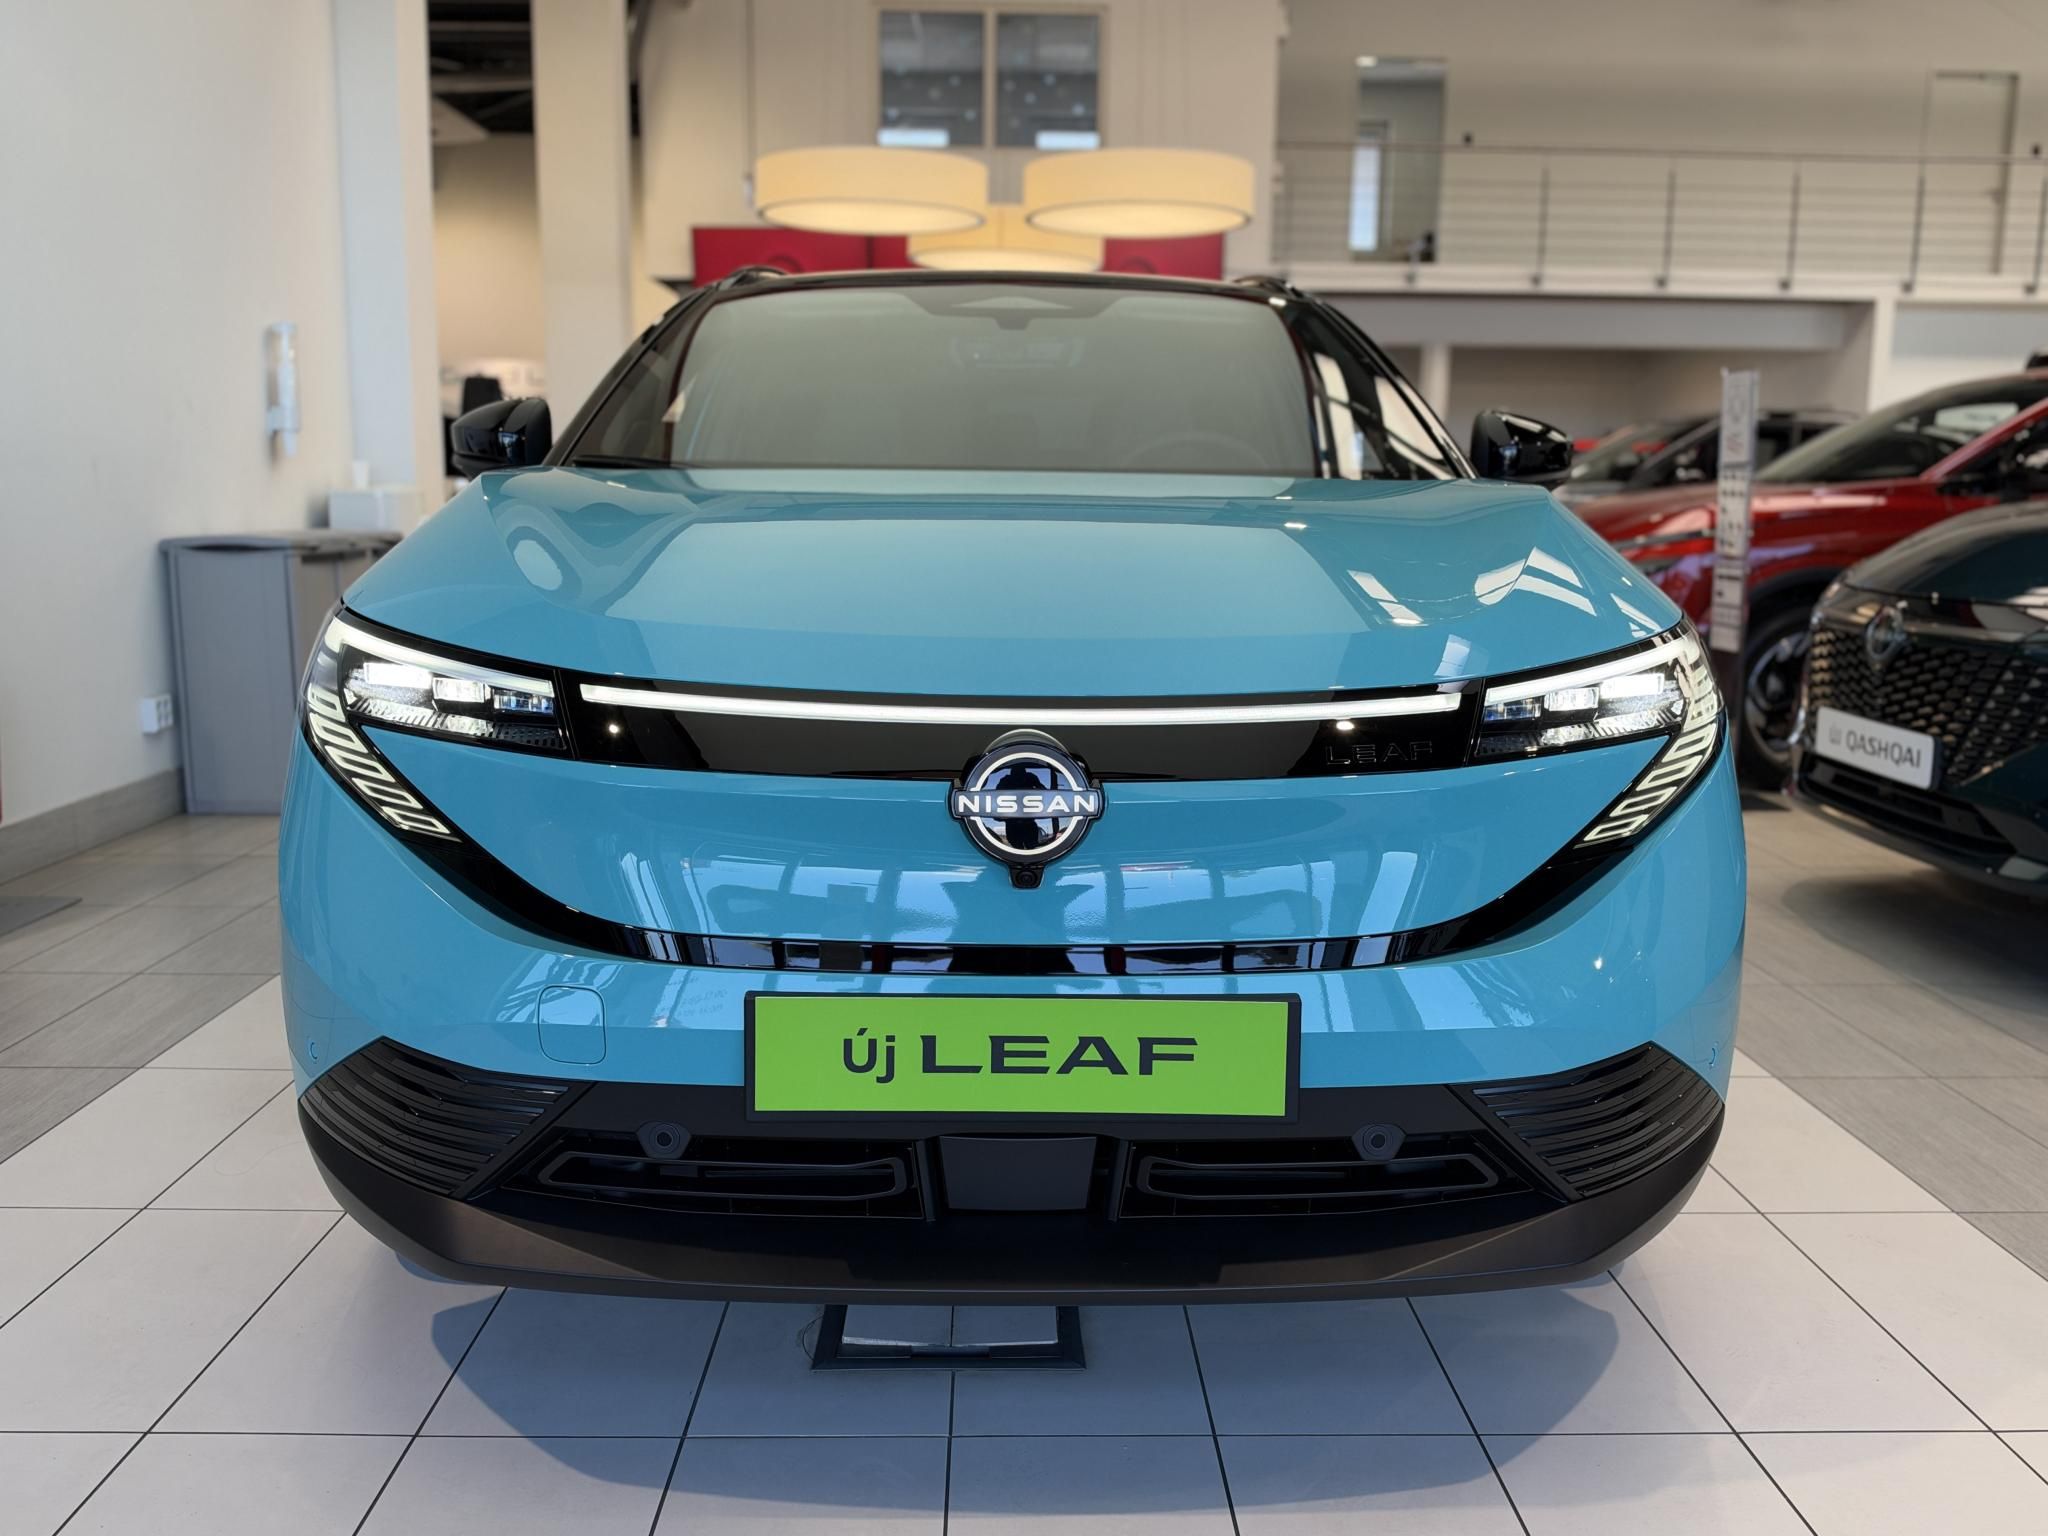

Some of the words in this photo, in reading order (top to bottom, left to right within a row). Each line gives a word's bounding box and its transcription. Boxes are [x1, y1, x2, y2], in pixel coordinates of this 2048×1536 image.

[1325, 740, 1433, 765] LEAF
[1845, 729, 1922, 768] QASHQAI
[957, 794, 1096, 814] NISSAN
[842, 1027, 896, 1084] Új
[919, 1035, 1199, 1076] LEAF
